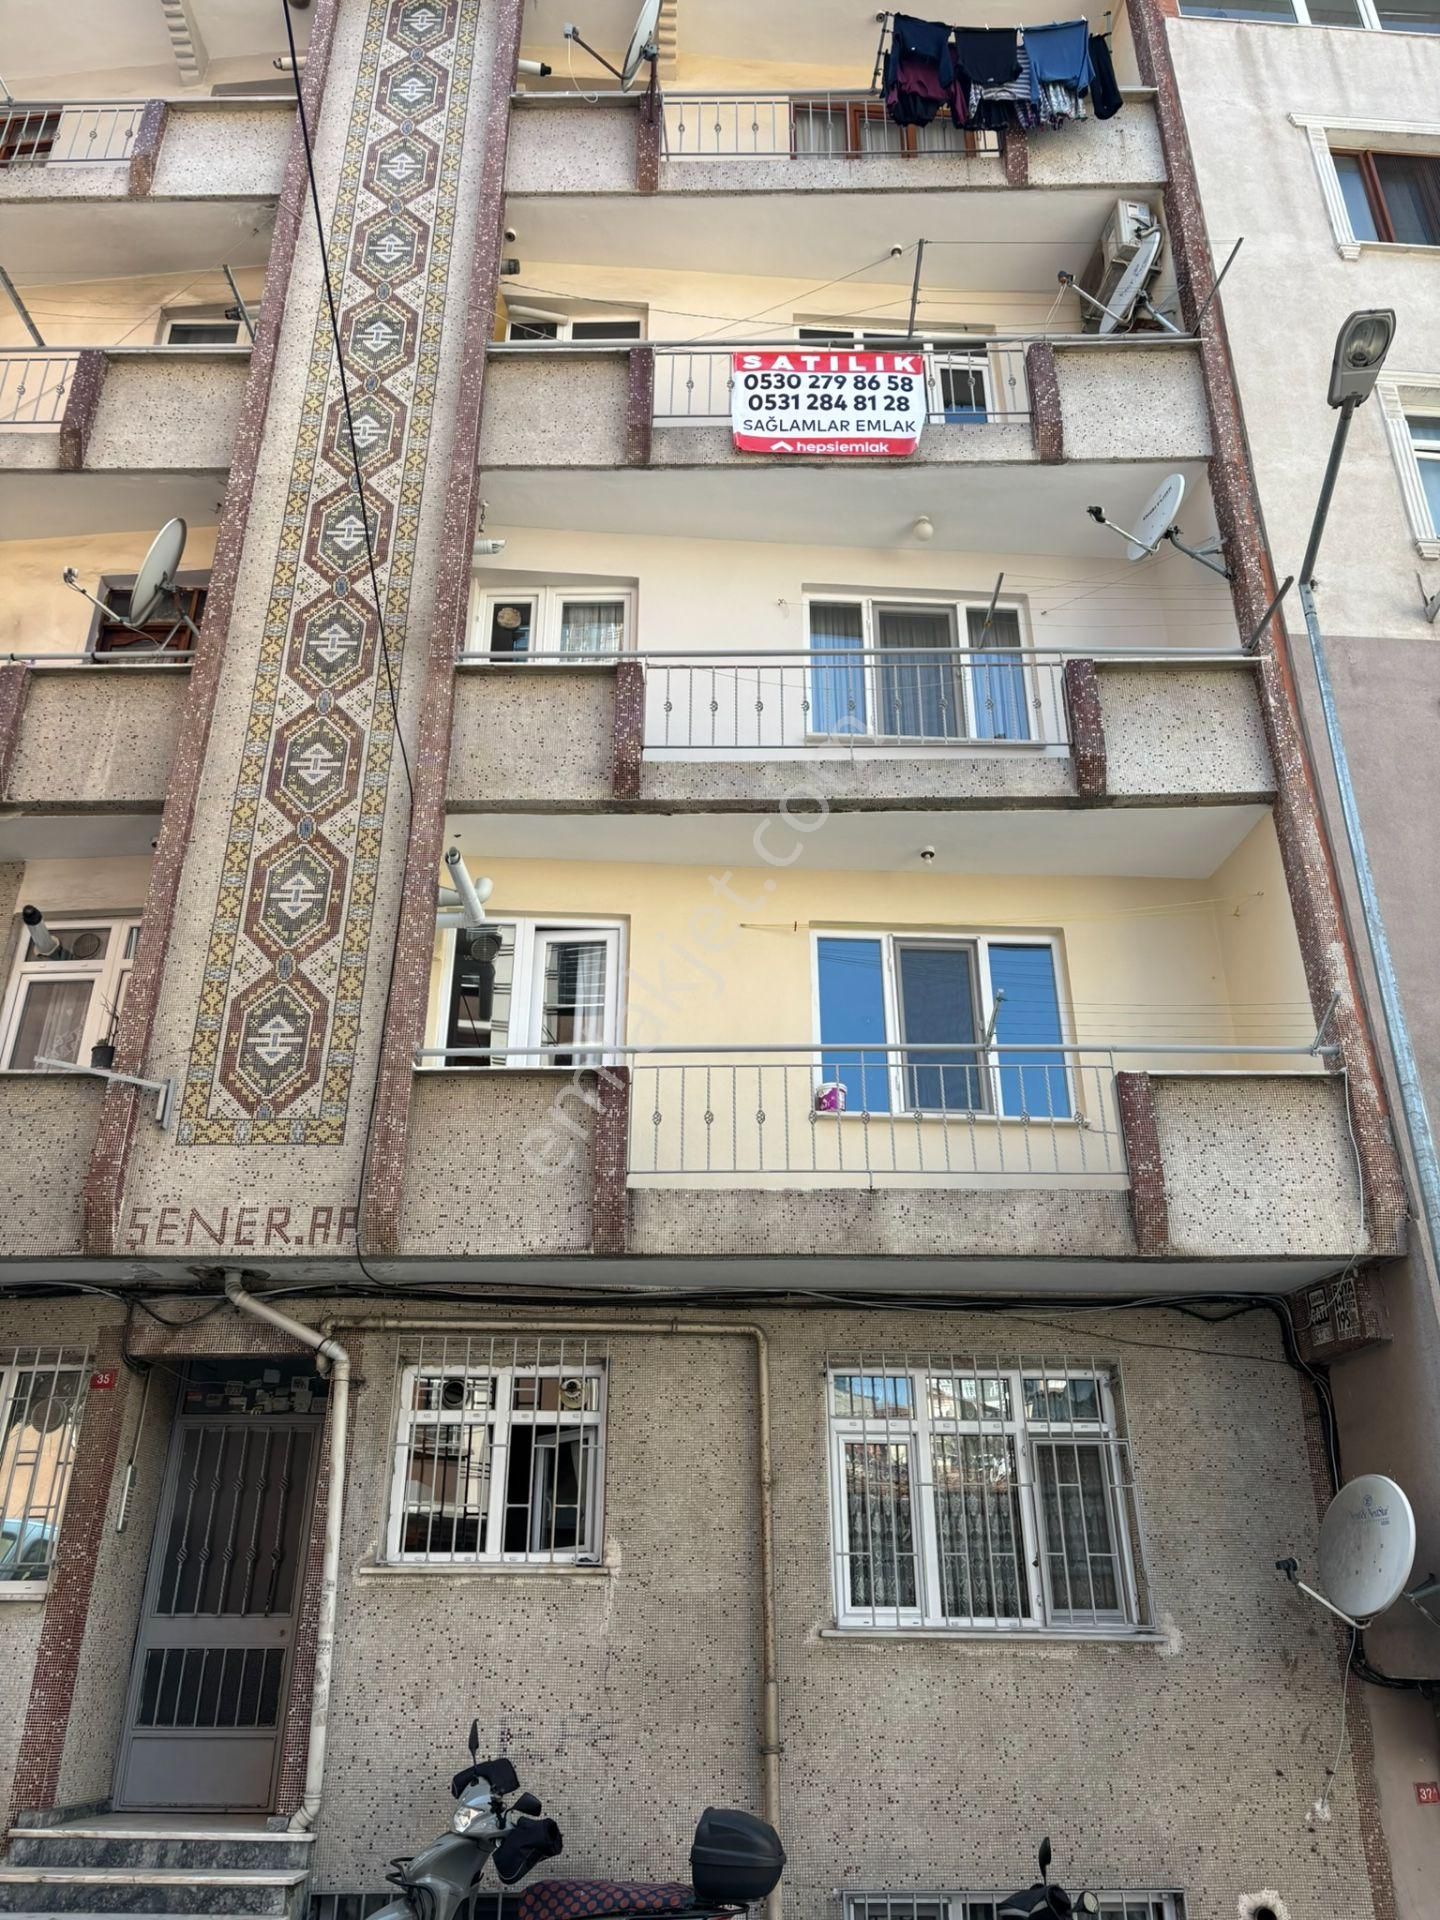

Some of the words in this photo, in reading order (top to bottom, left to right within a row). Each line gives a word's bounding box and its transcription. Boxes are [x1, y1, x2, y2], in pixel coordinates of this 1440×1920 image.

[743, 355, 916, 373] SATILIK
[744, 373, 801, 390] 0530
[808, 374, 847, 390] 279
[853, 375, 881, 391] 86
[887, 375, 914, 392] 58
[748, 394, 800, 411] 0531
[806, 394, 848, 411] 284
[853, 395, 877, 411] 81
[883, 395, 910, 411] 28
[743, 416, 850, 432] SAĞLAMLAR
[856, 420, 916, 432] EMLAK
[796, 441, 889, 453] hepsiemlak
[96, 1374, 110, 1384] 35
